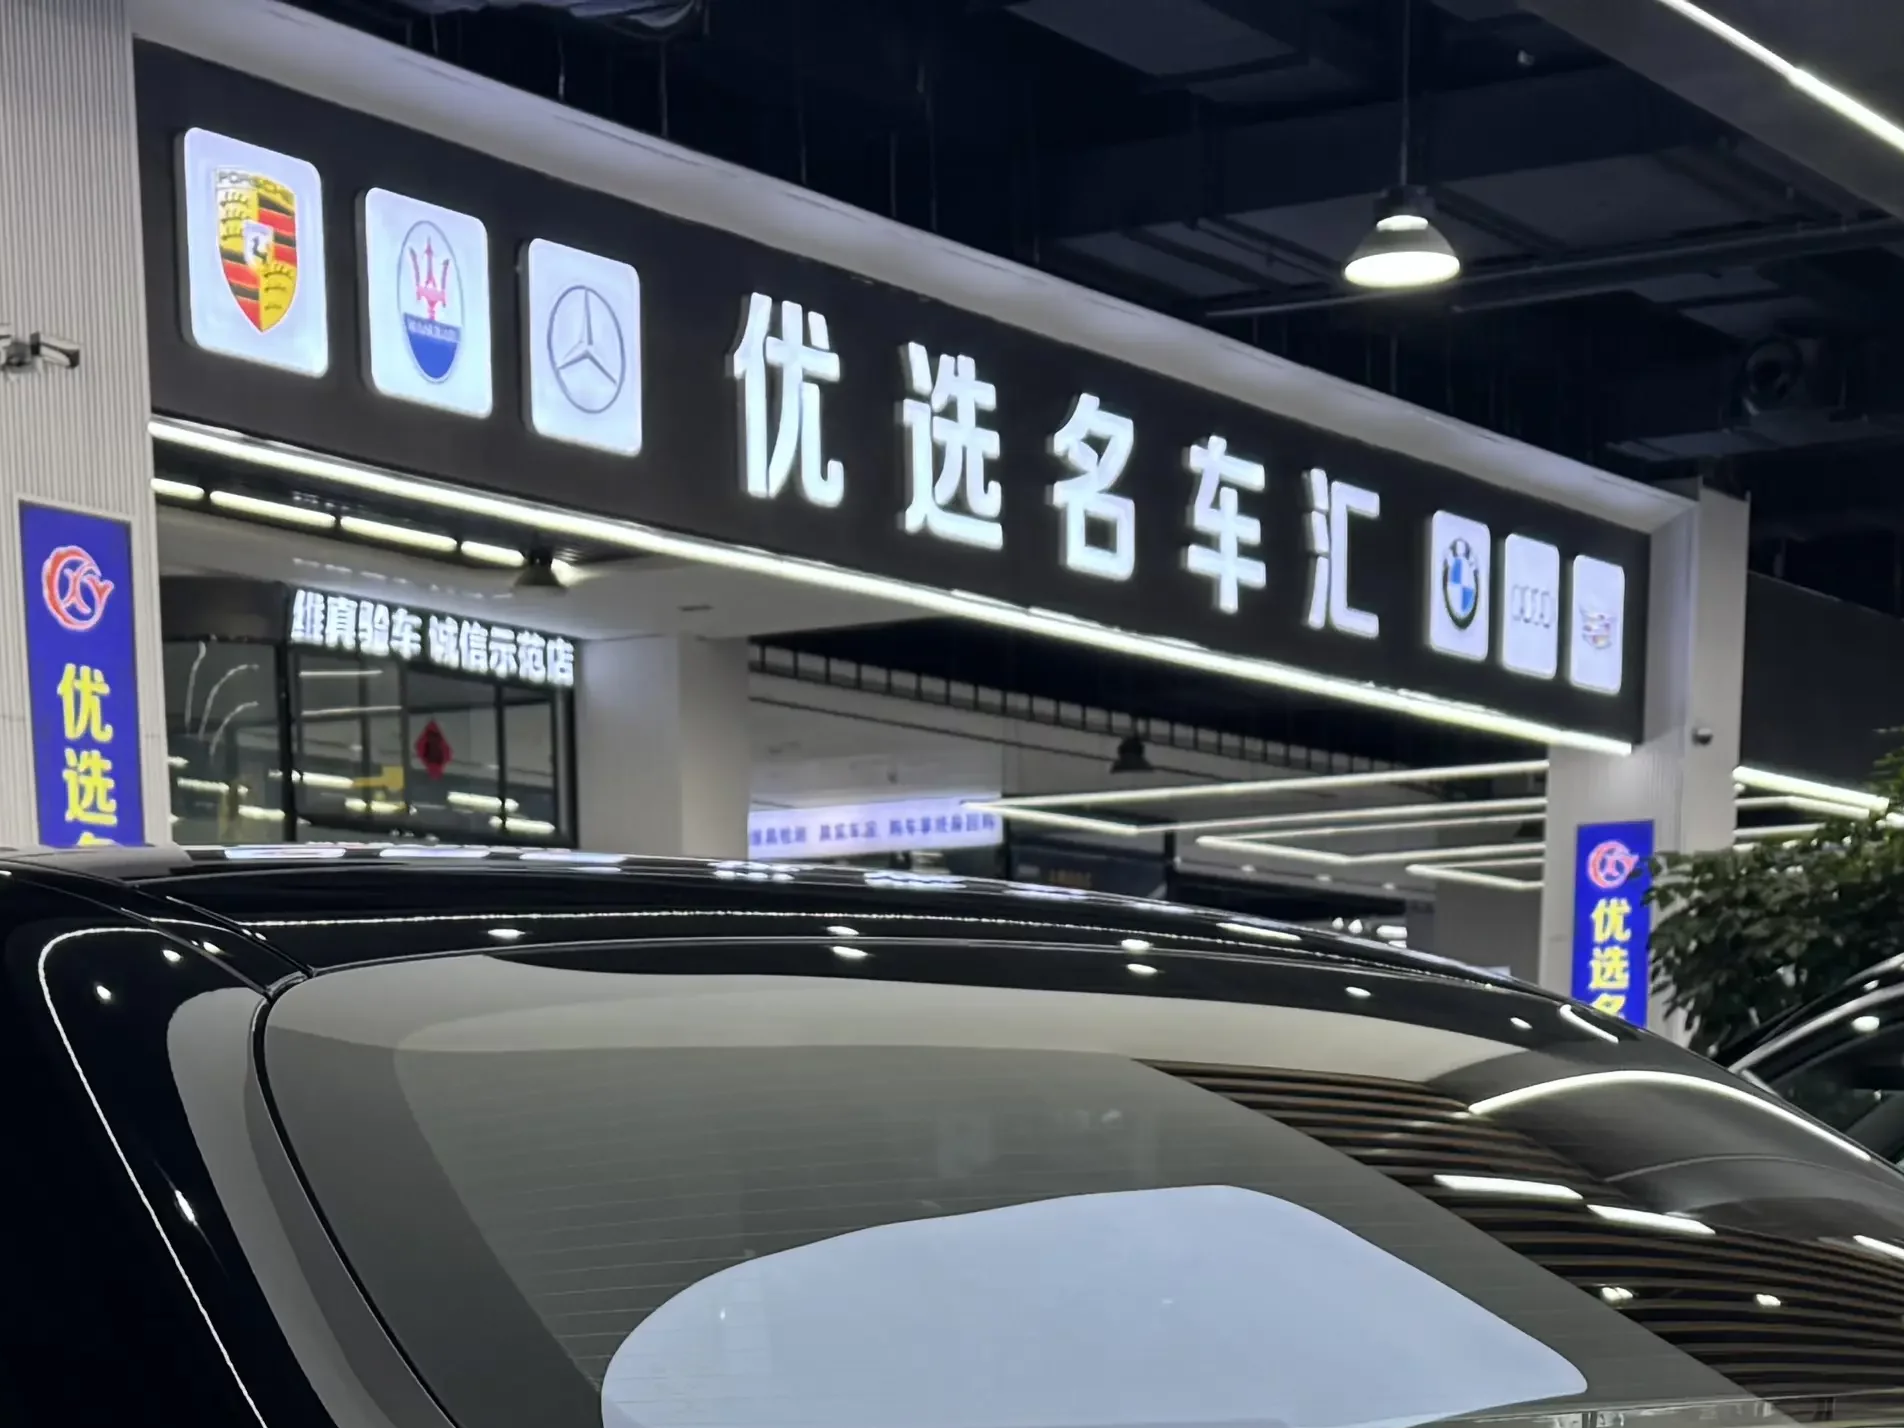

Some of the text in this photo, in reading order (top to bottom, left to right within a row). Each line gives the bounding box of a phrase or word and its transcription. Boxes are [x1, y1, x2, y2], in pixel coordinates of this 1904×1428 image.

[732, 291, 1382, 639] 优选名车汇
[57, 663, 120, 846] 优选
